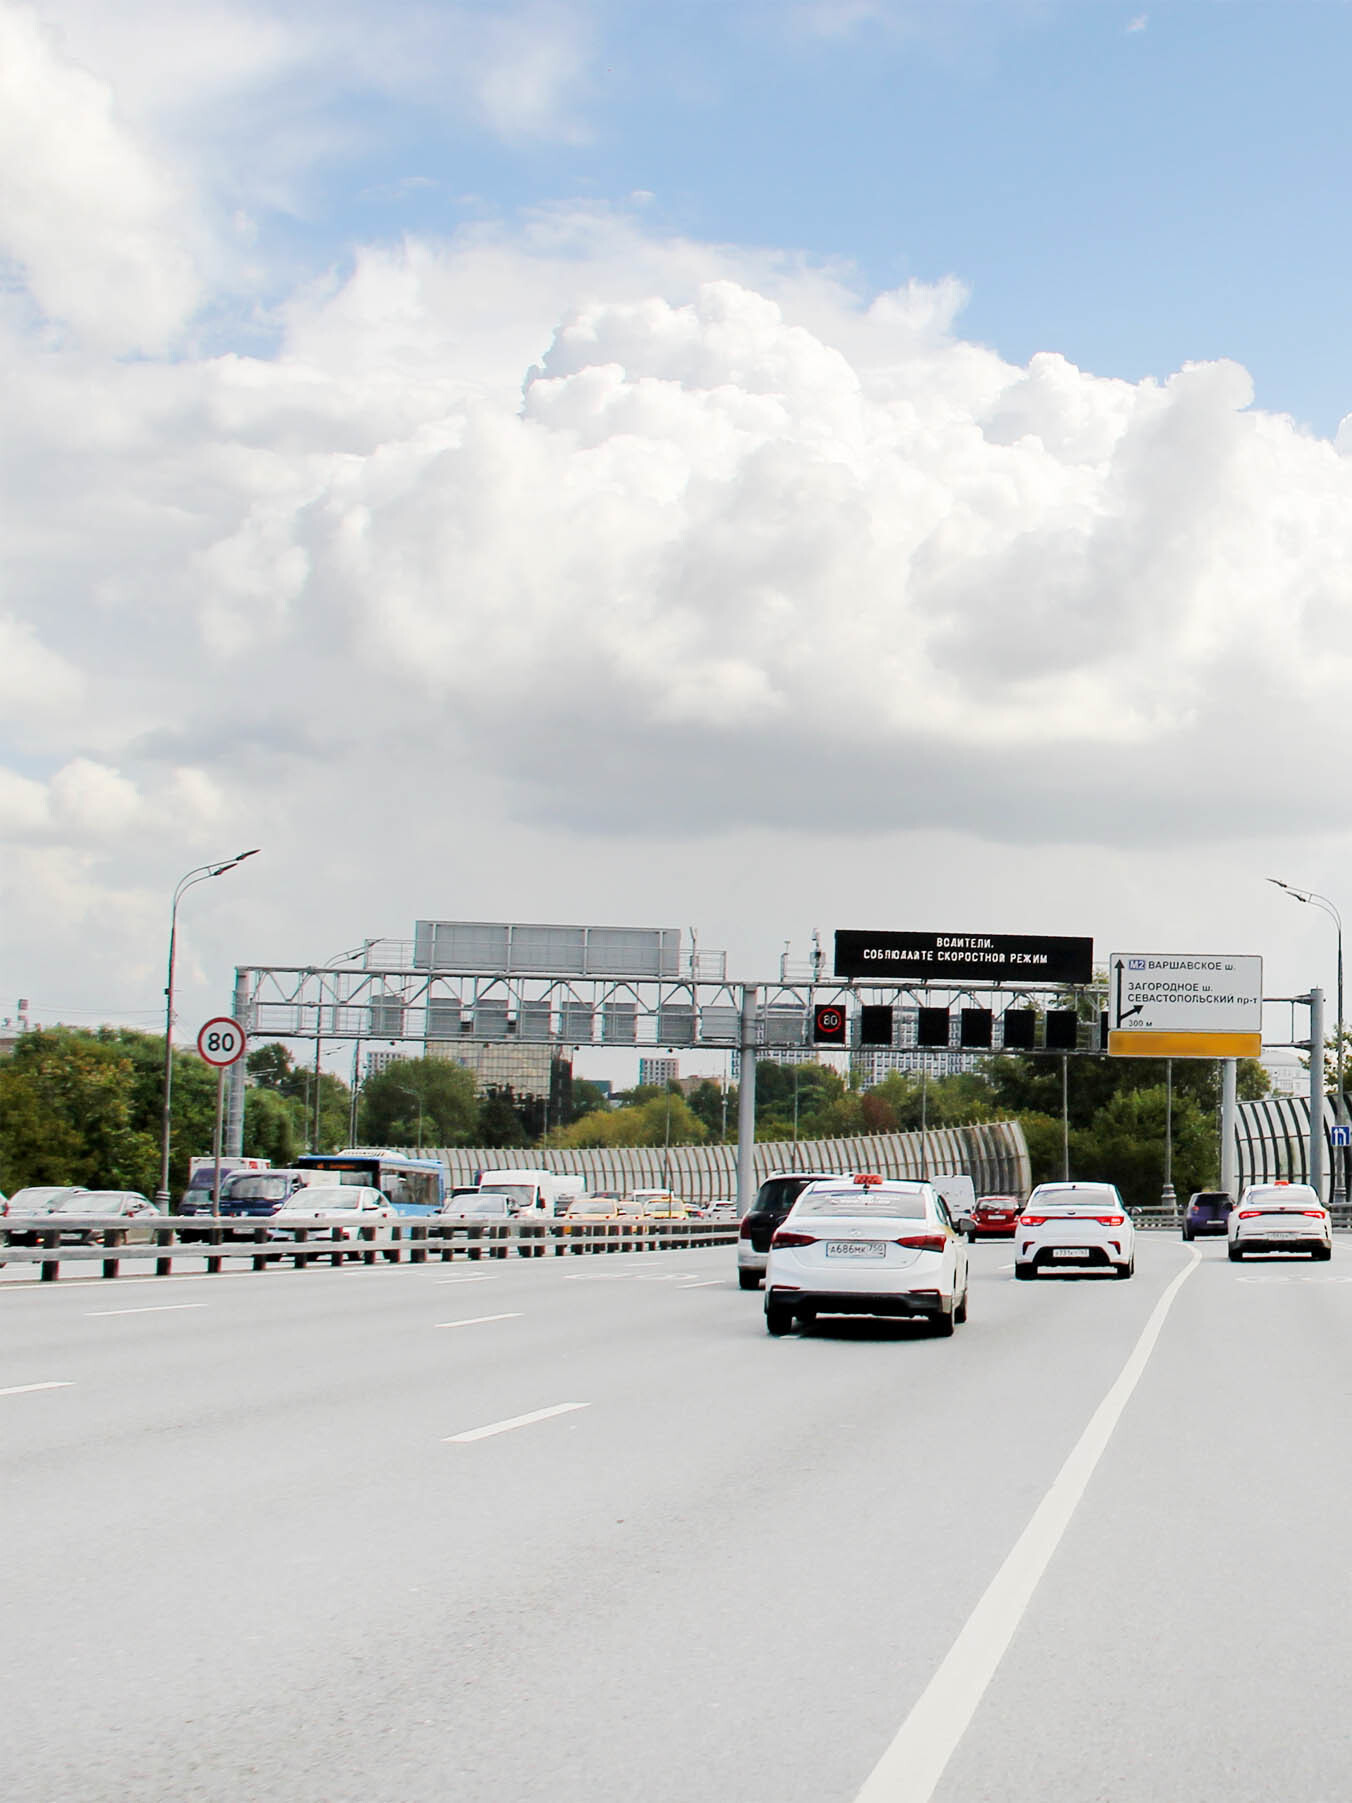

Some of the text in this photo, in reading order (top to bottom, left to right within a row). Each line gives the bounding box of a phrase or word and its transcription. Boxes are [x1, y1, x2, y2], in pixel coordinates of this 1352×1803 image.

[1009, 953, 1048, 964] РЕЖИМ
[1148, 961, 1222, 971] ВАРШАВСКОЕ
[1128, 982, 1199, 992] ЗАГОРОДНОЕ
[1127, 994, 1257, 1005] СЕВАСТОПОЛЬСКИЙ пр-т
[823, 1014, 838, 1026] 80
[207, 1032, 234, 1052] 80
